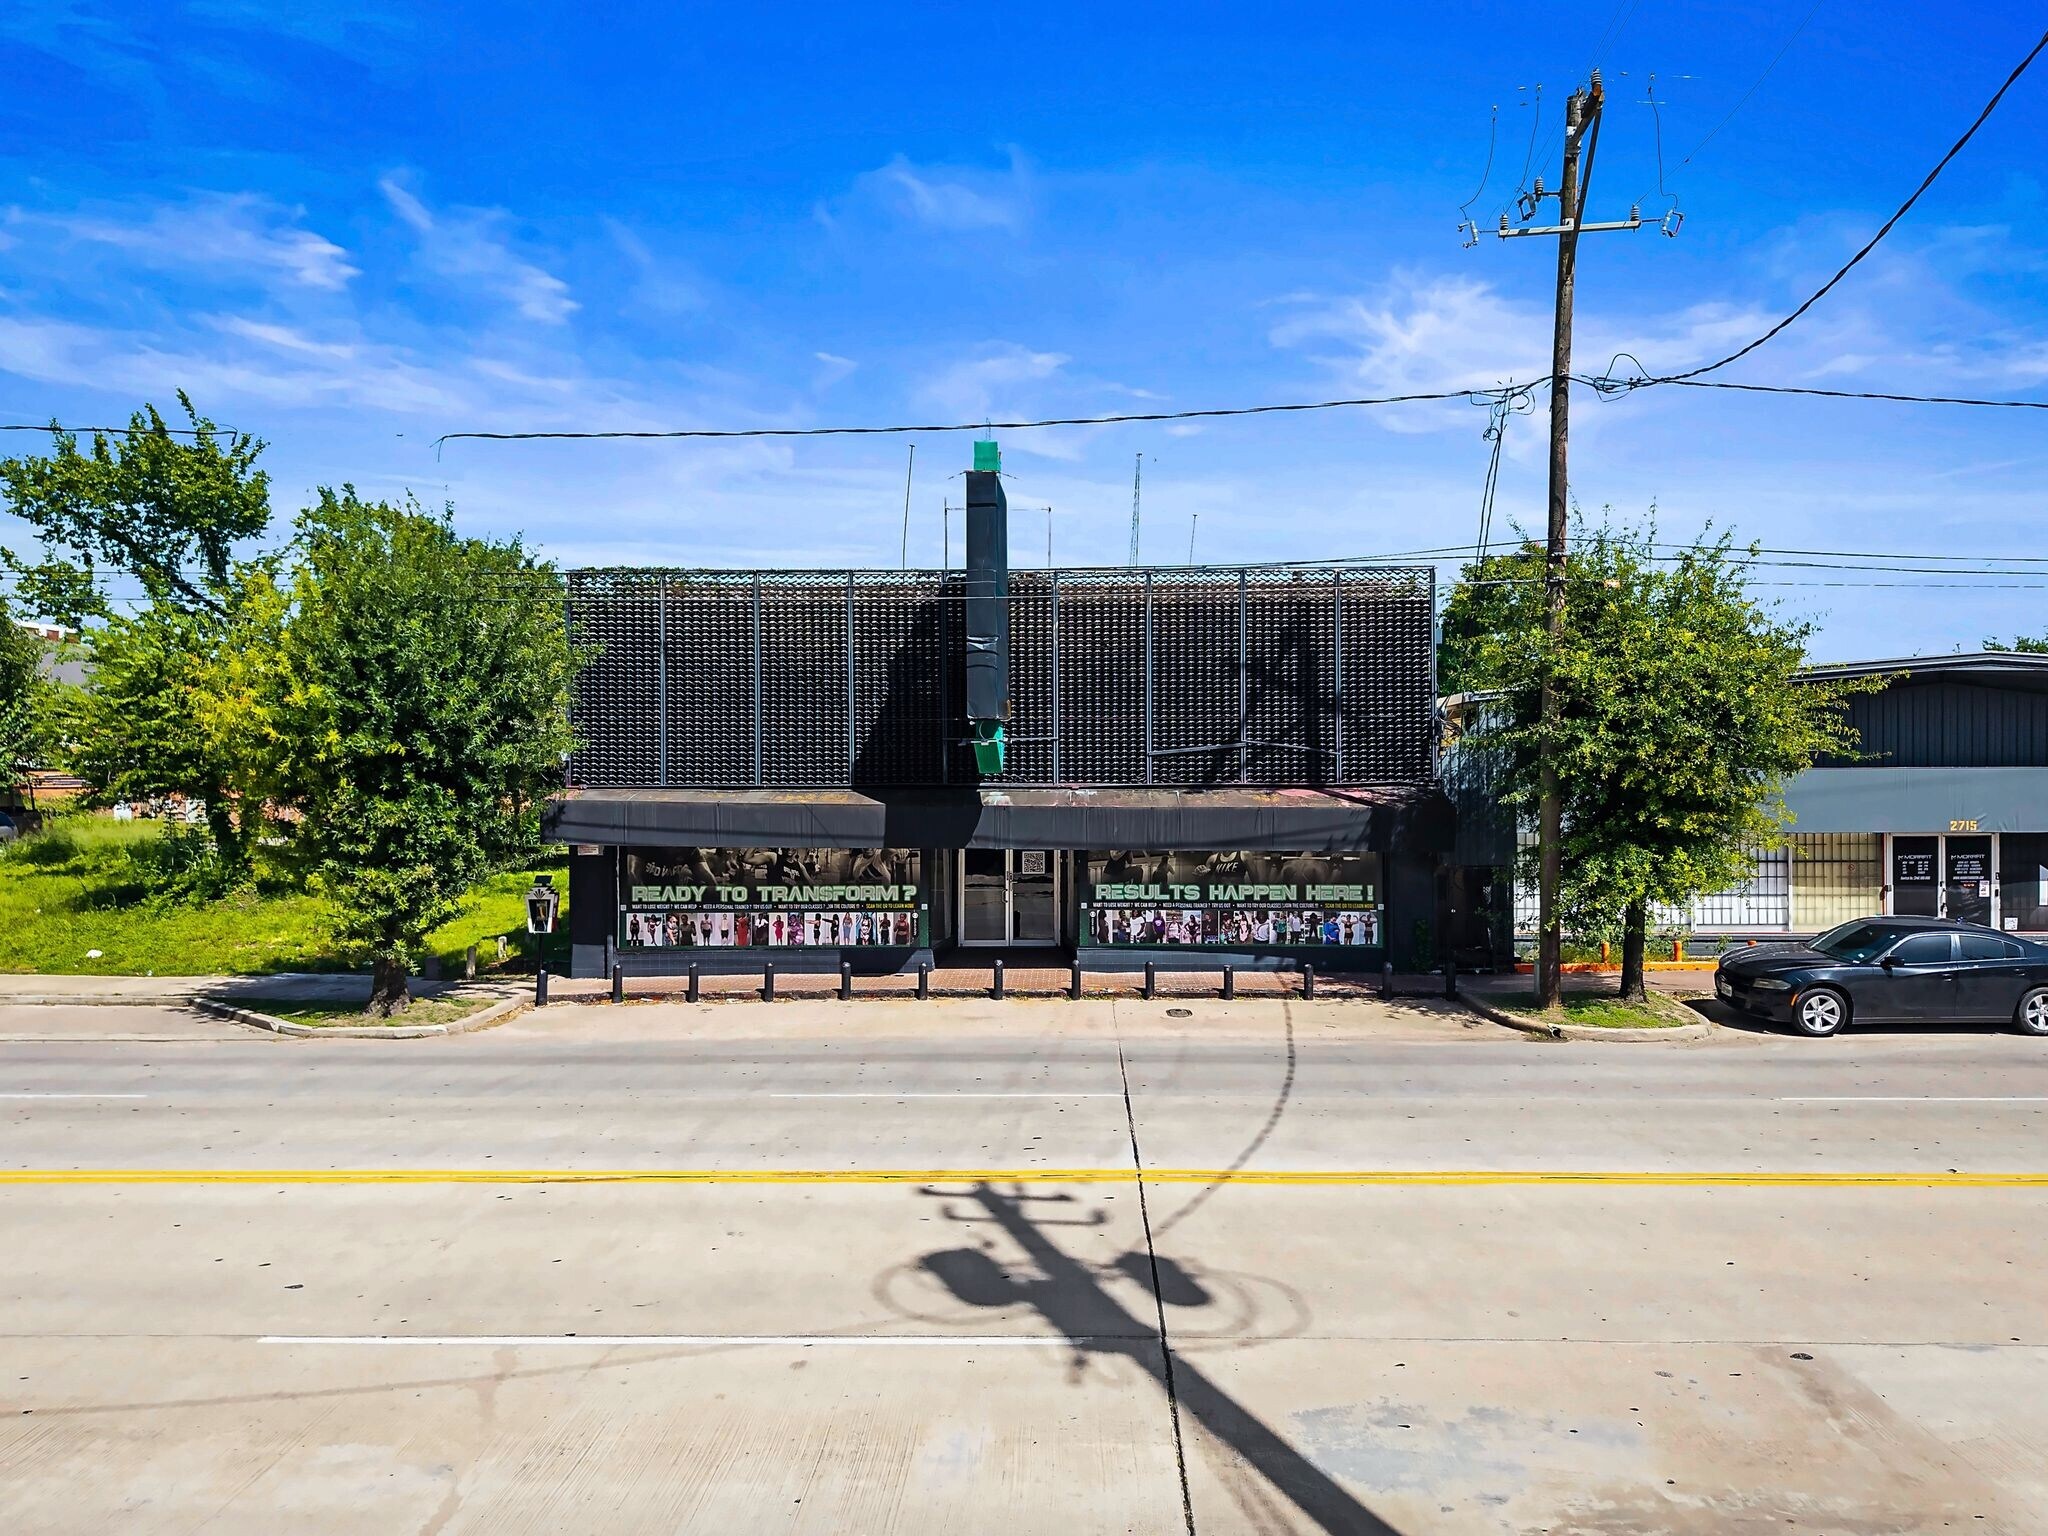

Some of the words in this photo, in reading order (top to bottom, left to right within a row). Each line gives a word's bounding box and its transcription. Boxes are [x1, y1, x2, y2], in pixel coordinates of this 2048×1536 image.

[1950, 820, 1977, 831] 2715
[631, 885, 707, 902] READY
[716, 886, 748, 902] TO
[1095, 884, 1200, 900] RESULTS
[1209, 884, 1297, 901] HAPPEN
